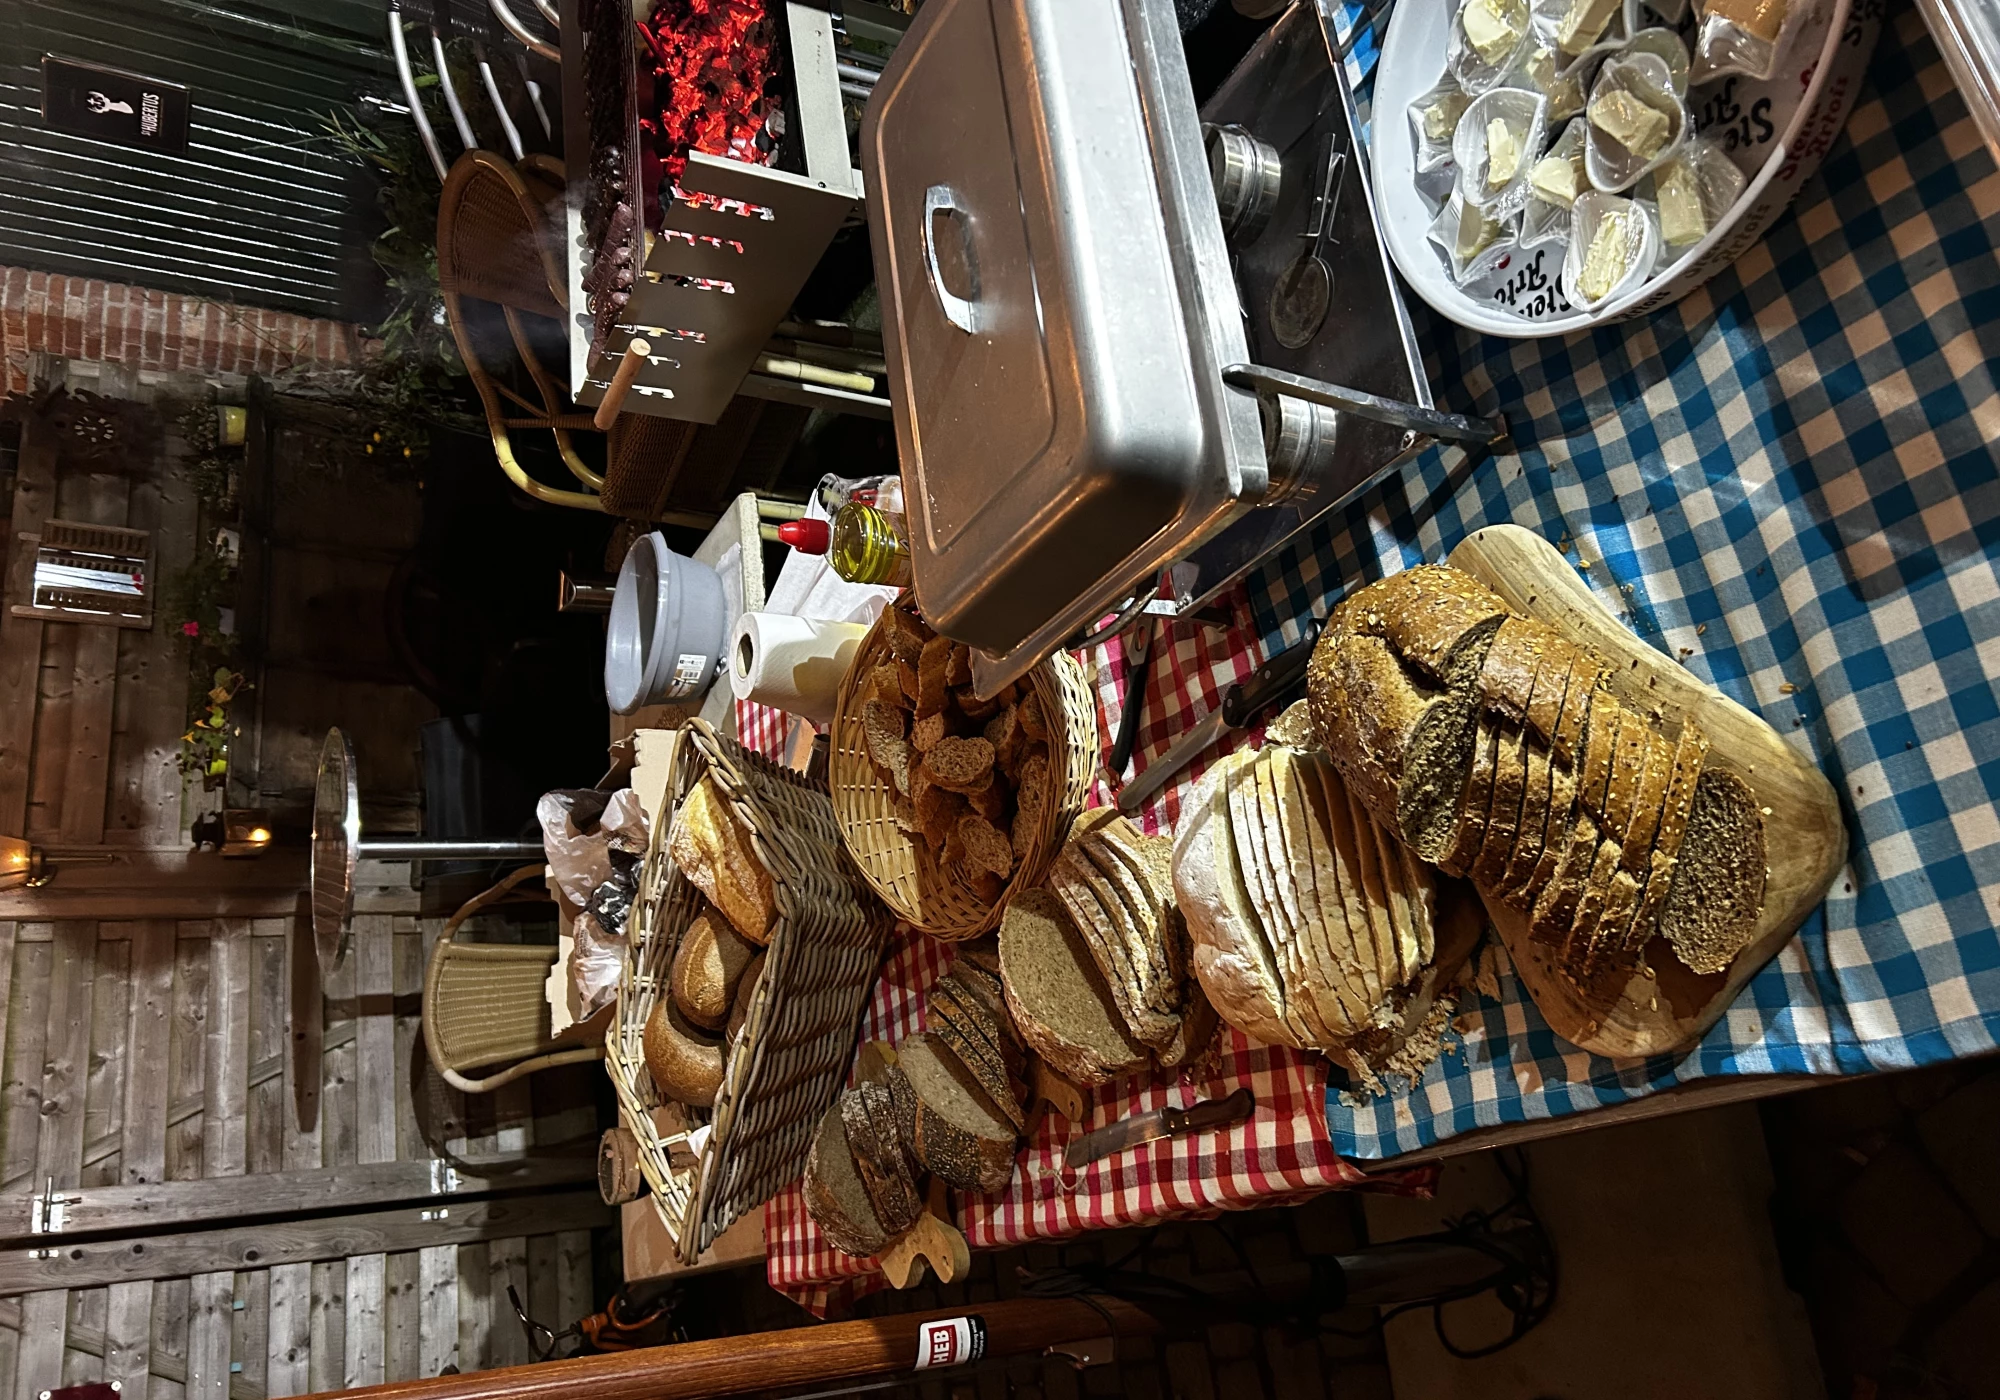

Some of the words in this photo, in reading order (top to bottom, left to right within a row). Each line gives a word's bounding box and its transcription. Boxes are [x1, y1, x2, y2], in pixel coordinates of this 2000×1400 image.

[141, 92, 160, 132] HUBERTUS
[1722, 97, 1775, 150] Ste
[932, 1330, 950, 1364] HEB
